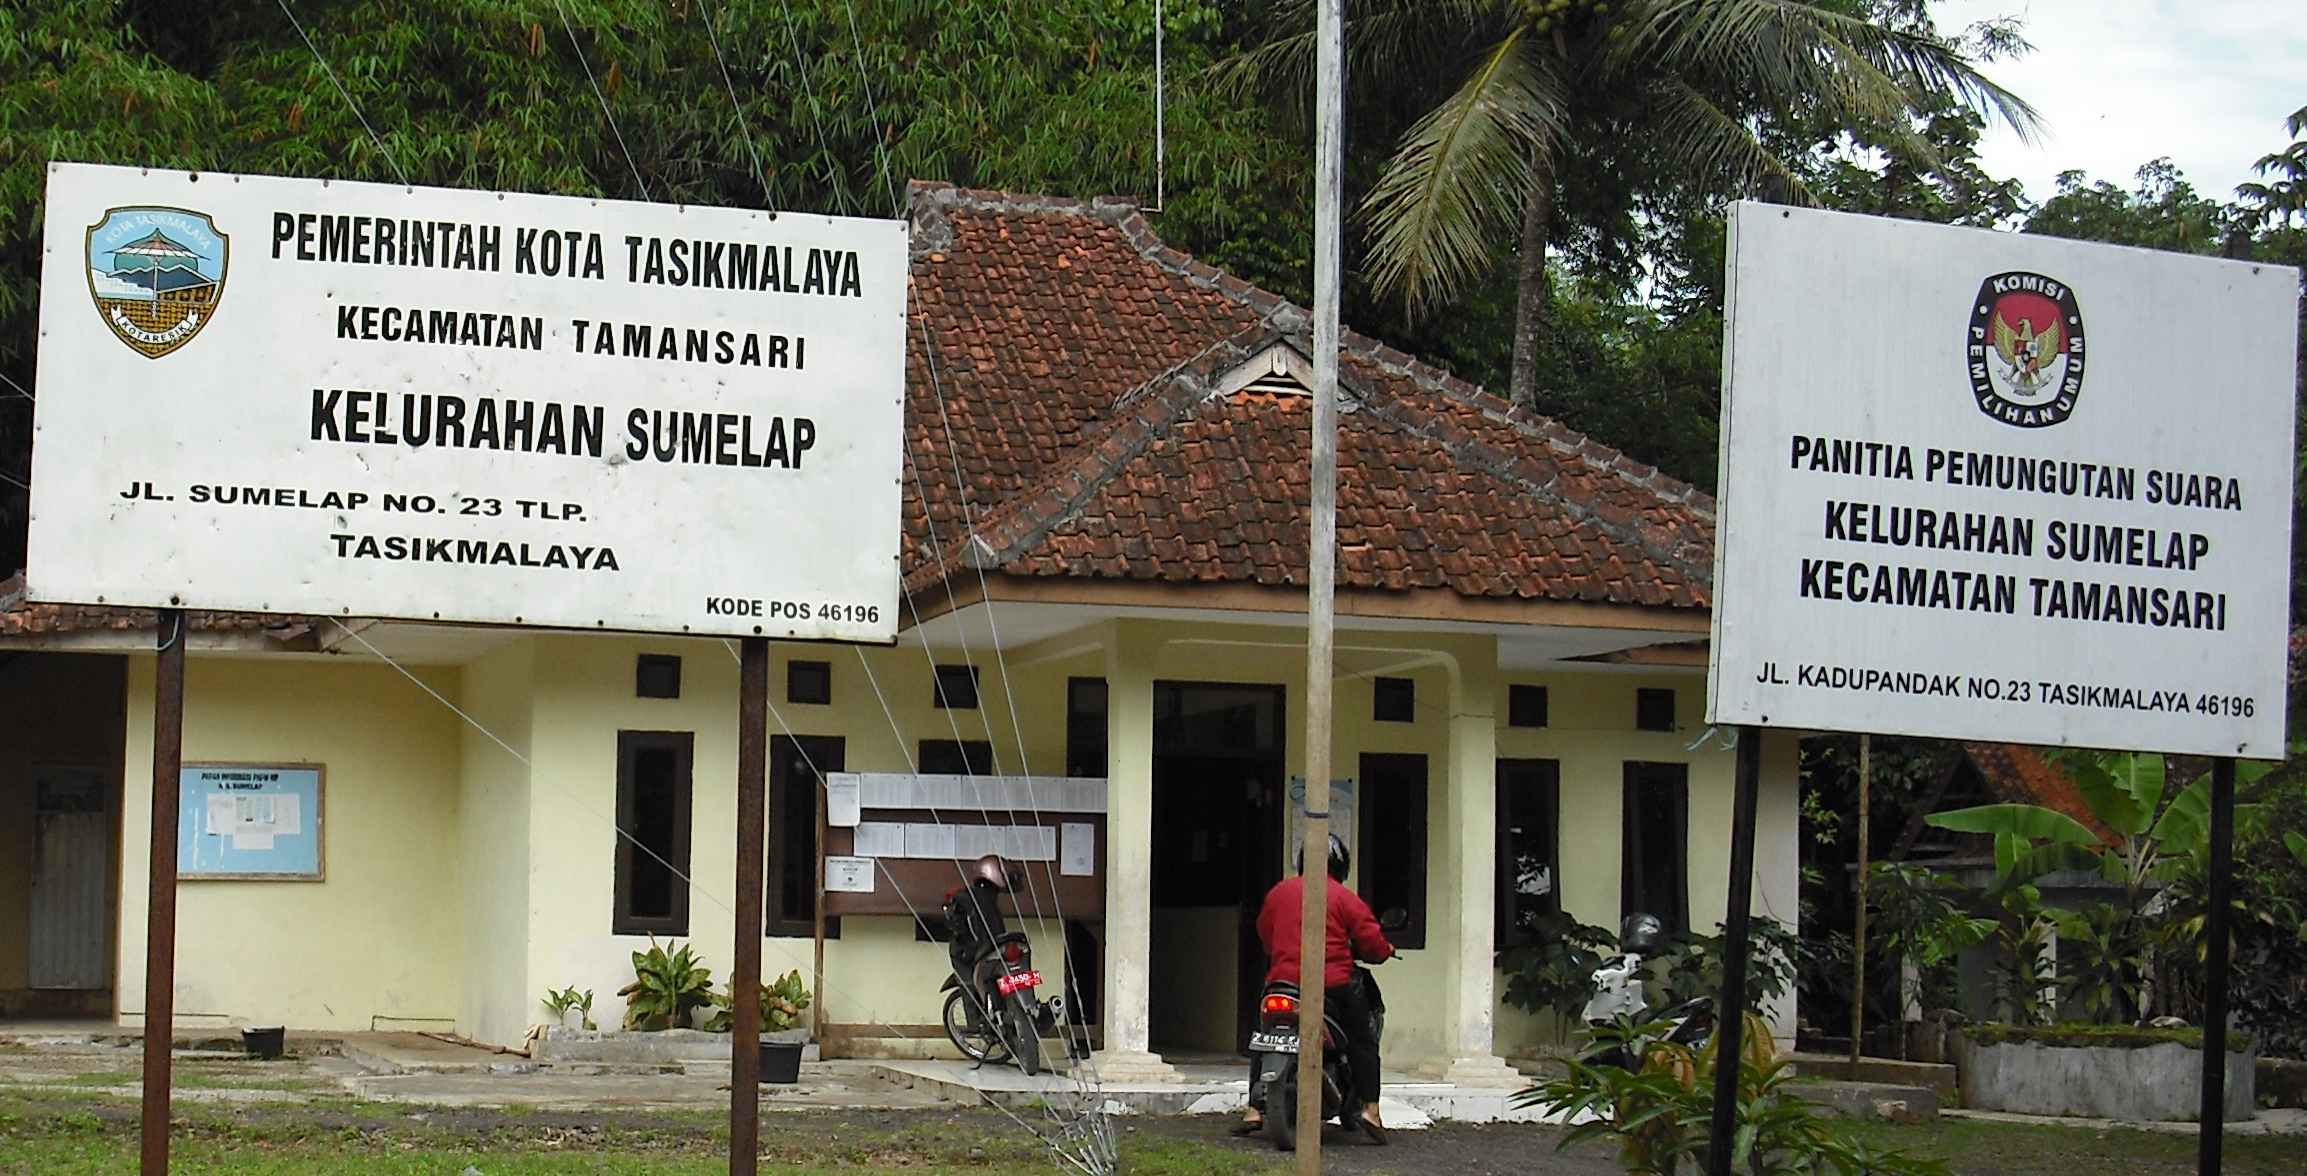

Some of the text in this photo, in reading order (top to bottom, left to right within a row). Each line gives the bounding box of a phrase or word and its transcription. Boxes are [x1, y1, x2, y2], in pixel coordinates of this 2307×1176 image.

[271, 211, 862, 299] PEMERINTAH KOTA TASIKMALAYA
[1992, 275, 2065, 301] KOMISI
[121, 319, 189, 343] KOTARESIK
[337, 305, 806, 370] KECAMATAN TAMANSARI
[1970, 326, 2083, 424] PEMILIHAN UMUM
[310, 389, 817, 471] KELURAHAN SUMELAP
[119, 481, 588, 521] JL. SUMELAP NO. 23 TLP.
[1790, 435, 2242, 511] PANITIA PEMUNGUTAN SUARA
[330, 533, 621, 571] TASIKMALAYA
[1825, 500, 2210, 572] KELURAHAN SUMELAP
[706, 597, 880, 623] KODE POS 46196
[1800, 558, 2227, 631] KECAMATAN TAMANSARI
[1756, 661, 2255, 718] JL. KADUPANDAK NO.23 TASIKMALAYA 46196
